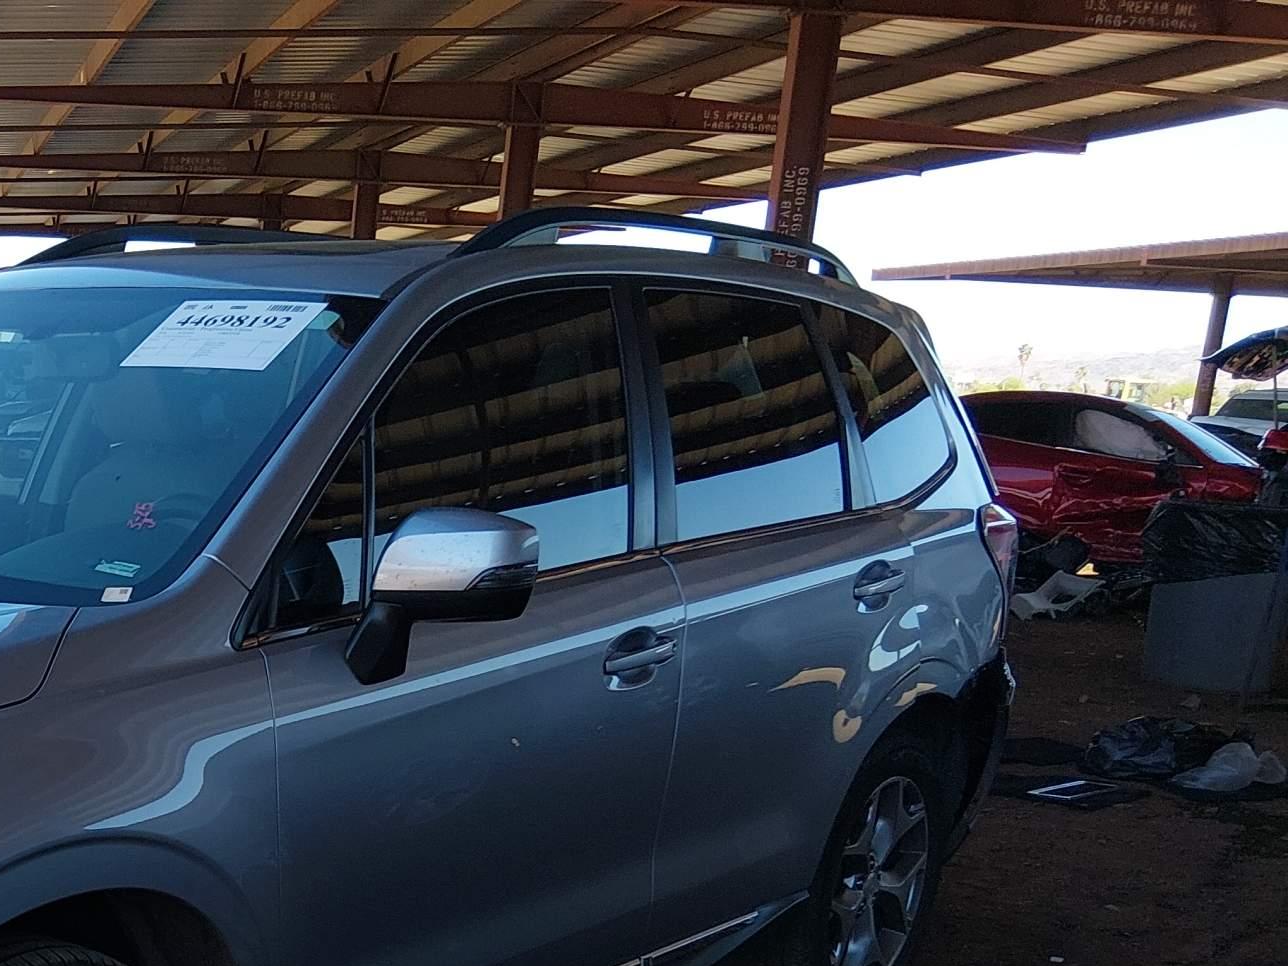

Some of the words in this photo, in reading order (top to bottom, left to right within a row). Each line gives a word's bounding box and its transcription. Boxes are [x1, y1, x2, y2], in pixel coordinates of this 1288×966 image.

[1118, 0, 1169, 15] PREFAB
[726, 111, 765, 122] PREFAB
[783, 165, 798, 193] INC.
[176, 314, 292, 329] 44698192
